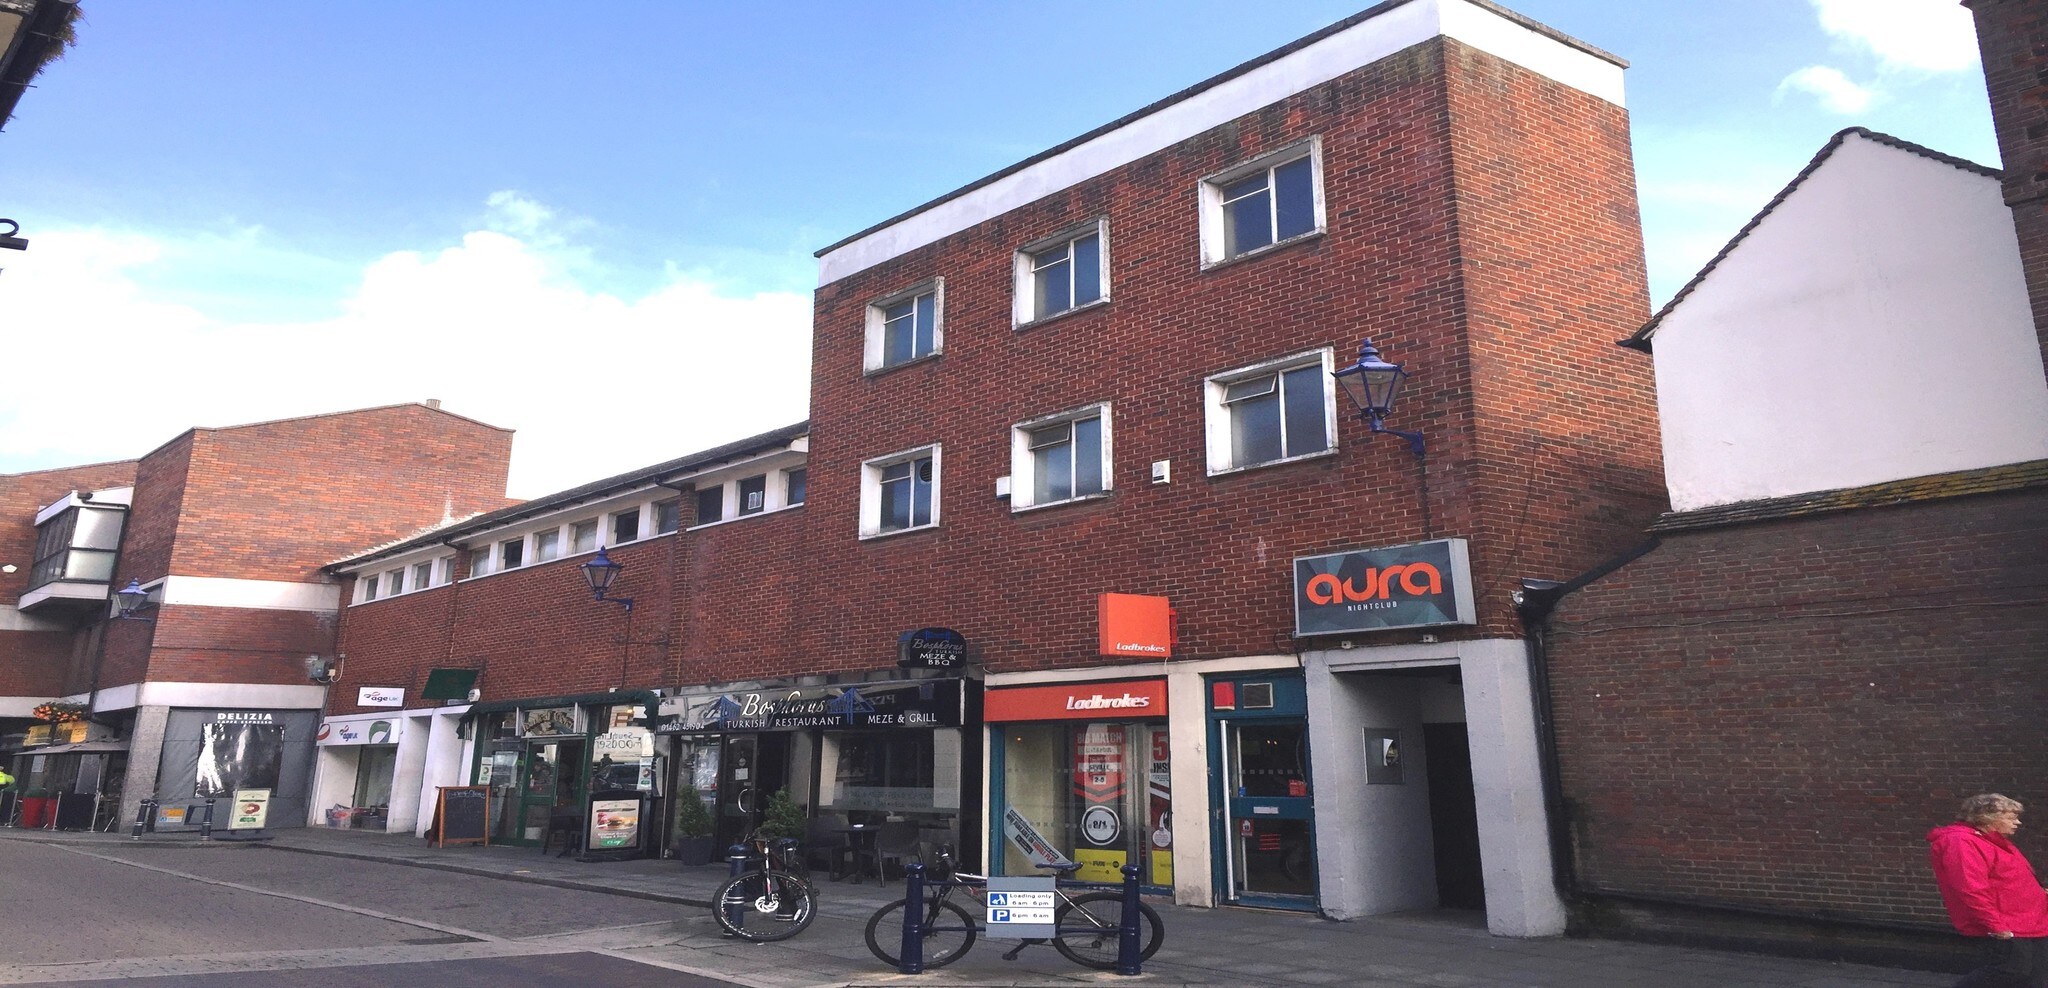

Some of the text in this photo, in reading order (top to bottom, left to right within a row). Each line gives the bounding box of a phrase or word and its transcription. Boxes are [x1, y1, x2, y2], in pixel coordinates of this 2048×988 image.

[1306, 562, 1442, 605] aura
[1347, 601, 1398, 611] NIGHTCLUB
[912, 638, 963, 654] Bosphorus
[1116, 642, 1165, 652] Ladbrokes
[742, 690, 825, 724] Bosphorus
[1066, 693, 1150, 710] Ladbrokes
[726, 716, 841, 728] TURKISH RESTAURANT
[867, 712, 937, 724] MEZE & GRILL
[661, 723, 680, 732] 01462
[996, 910, 1008, 921] P
